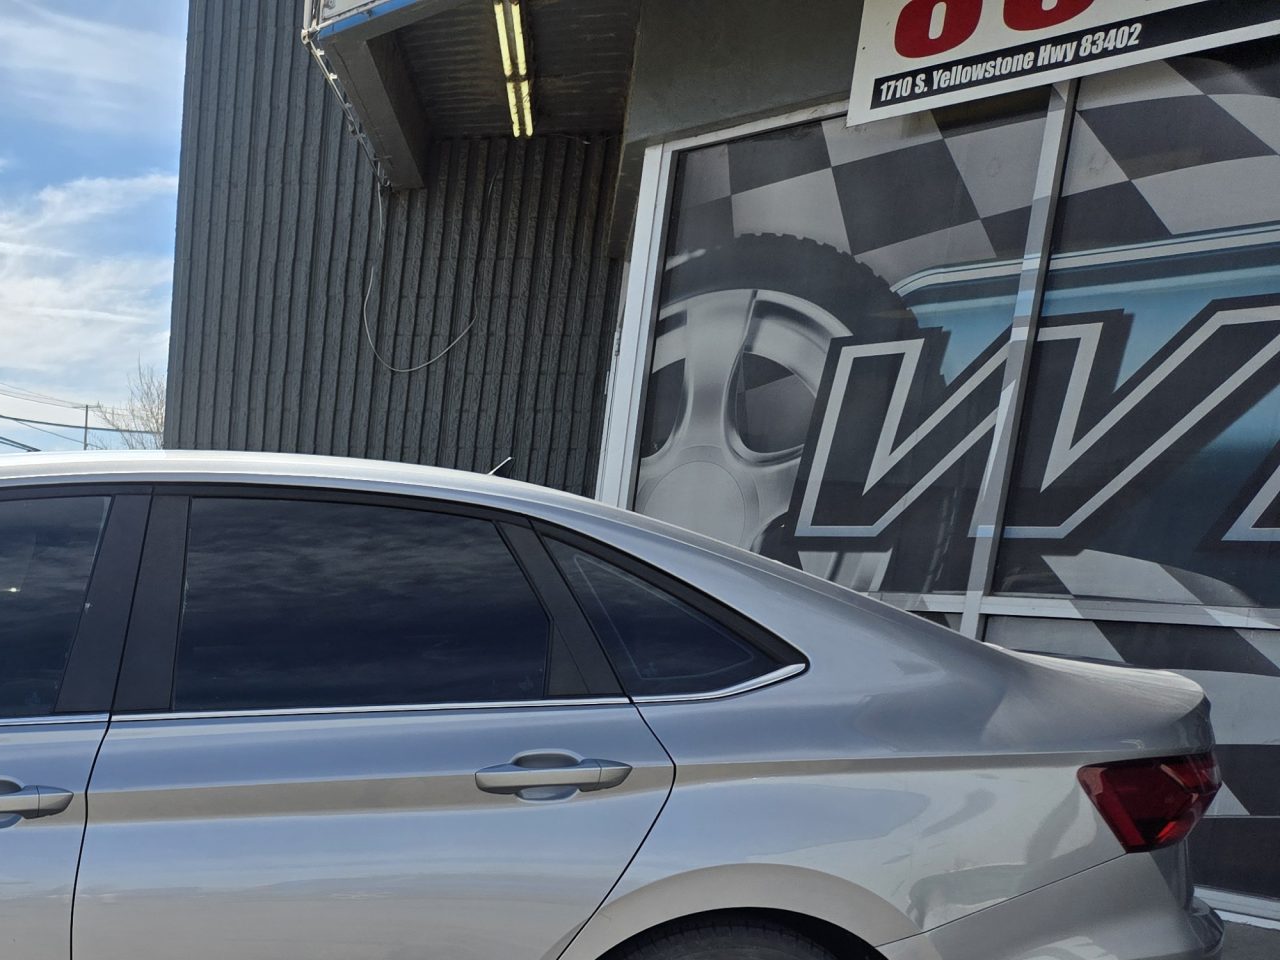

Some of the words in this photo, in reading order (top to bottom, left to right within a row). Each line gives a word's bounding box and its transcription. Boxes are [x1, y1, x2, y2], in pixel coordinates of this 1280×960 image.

[880, 76, 913, 102] 1710
[915, 73, 928, 94] S.
[932, 51, 1034, 90] Yellowstone
[1037, 41, 1078, 66] Hwy
[1078, 23, 1142, 57] 83402
